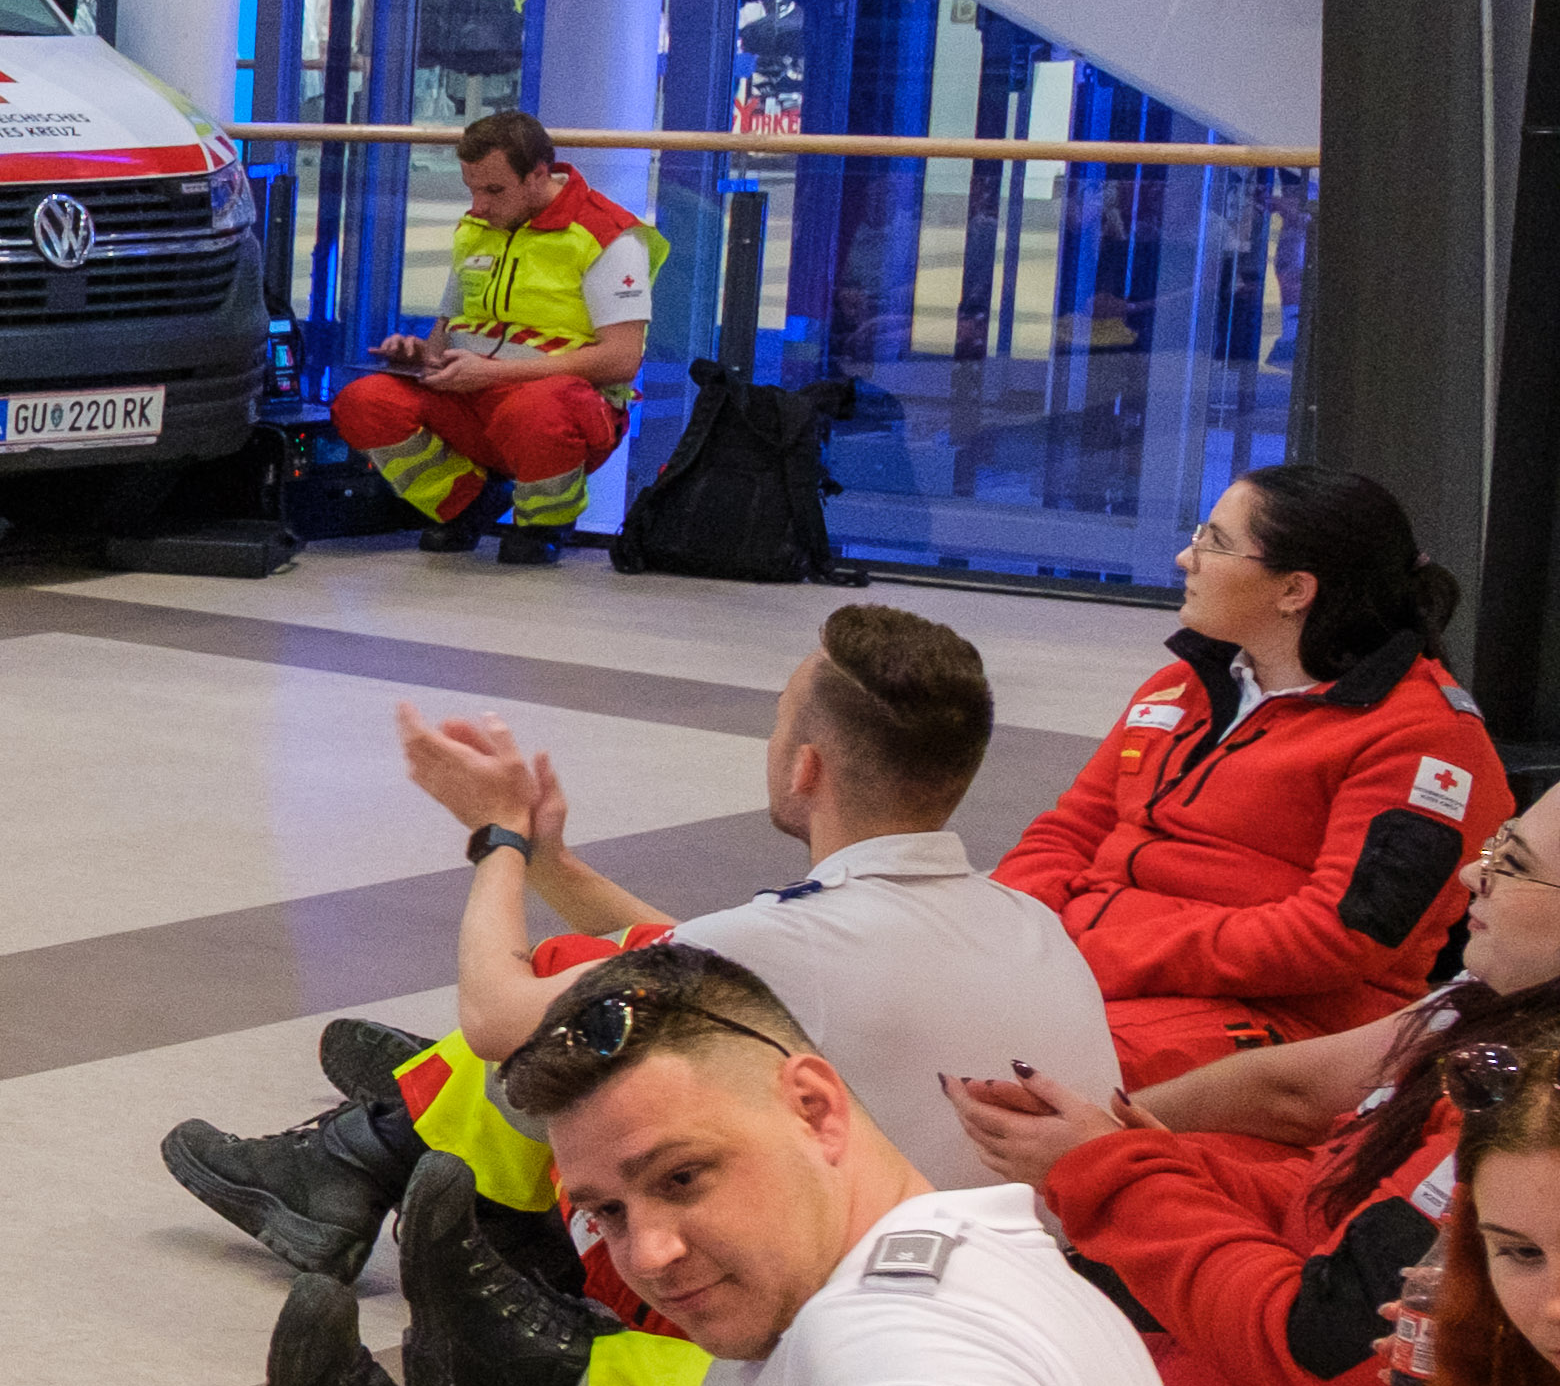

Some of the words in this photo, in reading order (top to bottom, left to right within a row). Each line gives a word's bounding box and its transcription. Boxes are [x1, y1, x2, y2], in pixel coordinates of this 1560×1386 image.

[28, 126, 82, 138] KREUZ
[14, 402, 48, 434] GU
[67, 398, 117, 432] 220
[123, 396, 154, 430] RK
